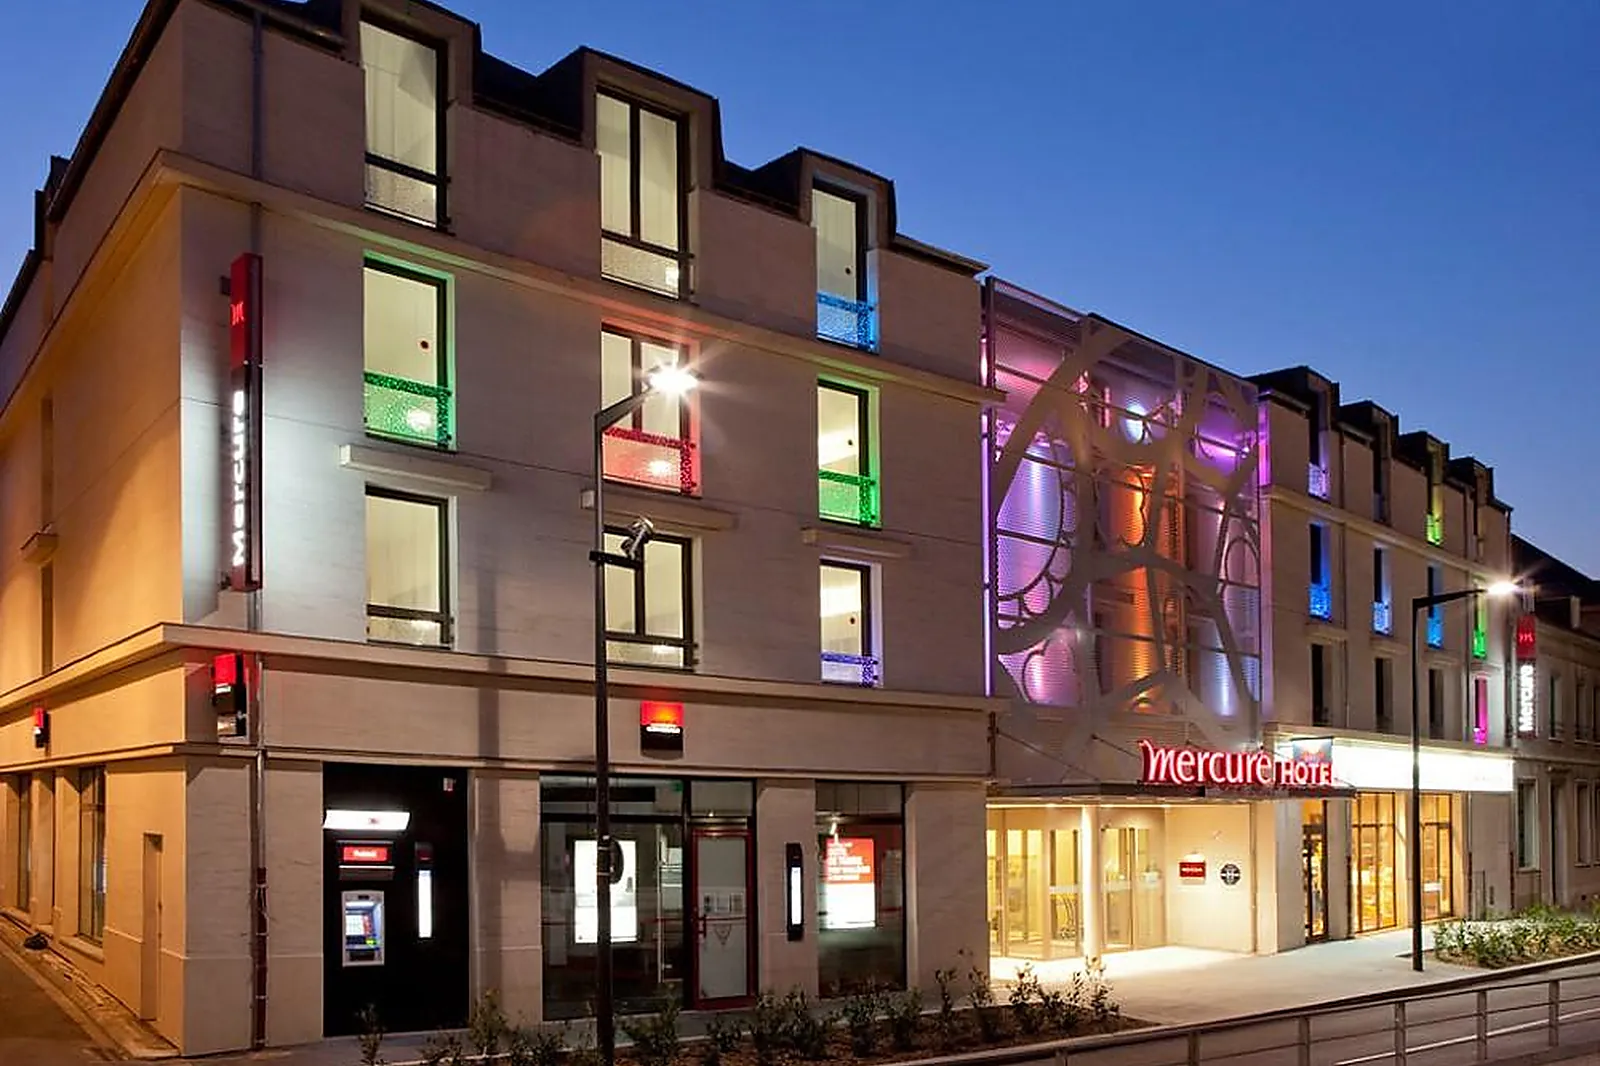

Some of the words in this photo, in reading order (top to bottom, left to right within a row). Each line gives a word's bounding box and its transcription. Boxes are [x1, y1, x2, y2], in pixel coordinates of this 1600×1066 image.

[232, 389, 245, 567] Mercure
[1518, 664, 1534, 732] Mercure
[1138, 739, 1272, 785] Mercure
